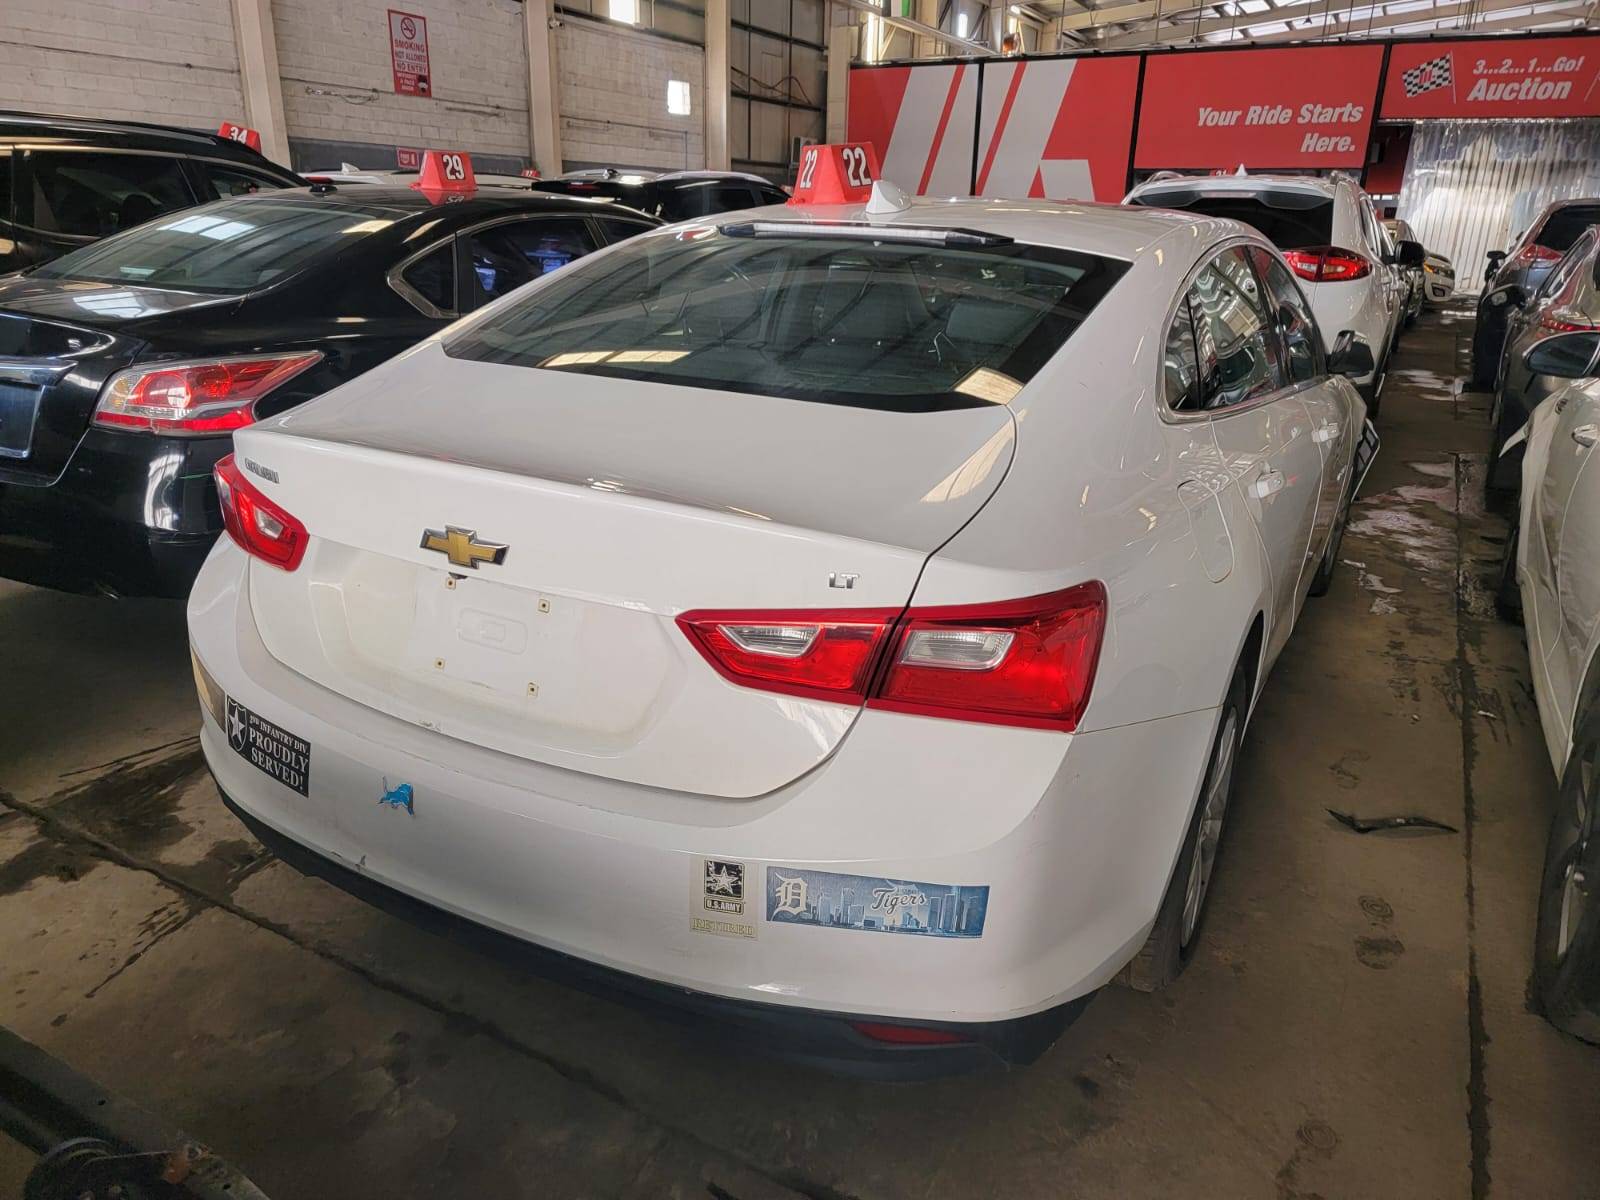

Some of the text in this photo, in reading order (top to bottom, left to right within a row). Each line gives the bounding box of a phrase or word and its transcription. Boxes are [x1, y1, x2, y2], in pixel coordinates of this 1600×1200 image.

[394, 39, 425, 53] SMOKING
[396, 60, 427, 73] NO ENTRY
[1467, 77, 1572, 101] Auction
[1198, 103, 1364, 127] Your Ride Starts
[229, 126, 248, 144] 34
[1300, 133, 1355, 152] Here.
[443, 155, 465, 180] 29
[800, 149, 817, 189] 22
[843, 147, 872, 187] 22
[829, 572, 860, 589] LT
[249, 727, 309, 773] PROUDLY
[260, 722, 293, 746] INFANTRY
[294, 740, 310, 755] DIV.
[251, 747, 304, 790] SERVED!
[872, 887, 927, 914] Tigers
